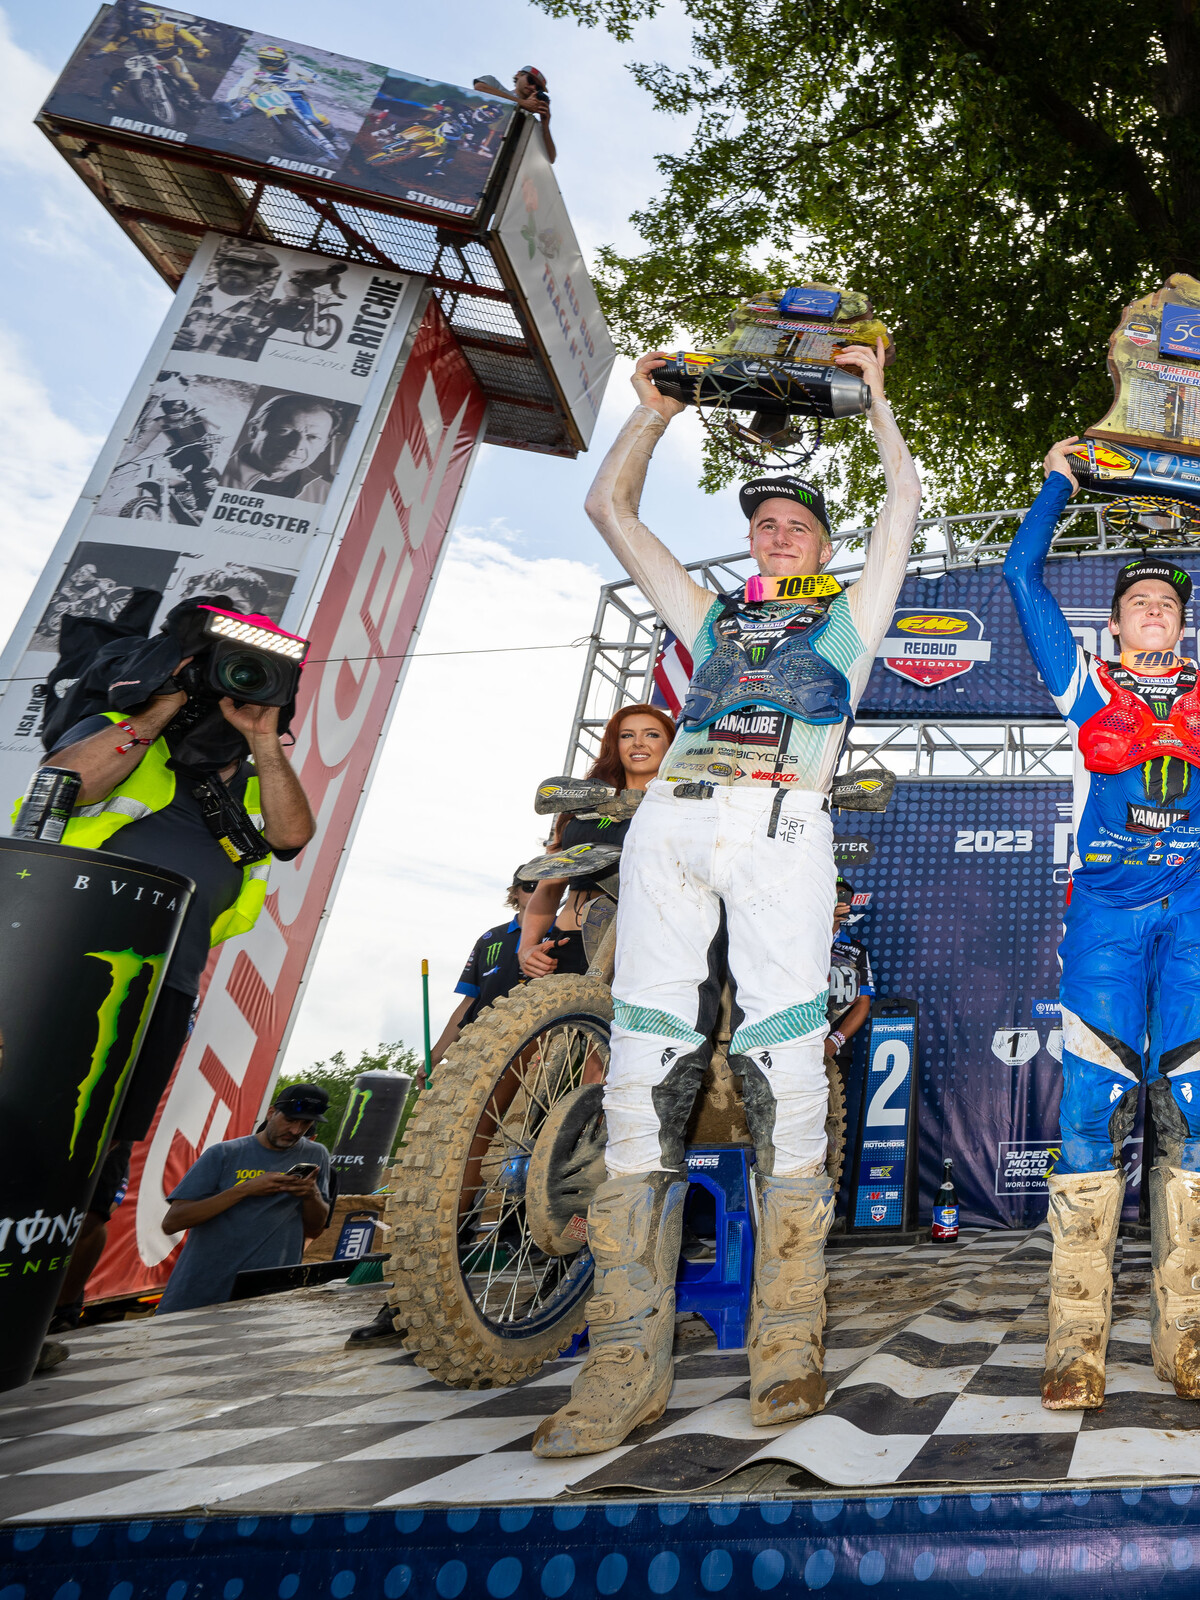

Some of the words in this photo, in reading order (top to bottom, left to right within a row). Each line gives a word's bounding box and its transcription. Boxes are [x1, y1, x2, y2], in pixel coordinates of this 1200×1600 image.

[110, 116, 188, 142] HARTWIG
[266, 156, 336, 180] BARNETT
[405, 190, 476, 215] STEWART
[791, 297, 834, 306] 50
[347, 276, 404, 350] RITCHIE
[755, 318, 778, 326] PAST
[778, 321, 832, 331] REDBUD
[776, 324, 828, 334] WINNERS
[351, 350, 376, 378] GENE
[1138, 361, 1167, 372] PAST
[754, 486, 796, 495] YAMAHA
[220, 493, 265, 508] ROGER
[212, 505, 311, 534] DECOSTER
[1136, 568, 1170, 576] YAMAHA
[776, 575, 836, 597] 100%
[720, 620, 734, 628] LK
[755, 621, 786, 629] YAMAHA
[796, 616, 813, 624] 43
[897, 617, 969, 630] FMF
[740, 630, 786, 640] THOR
[904, 642, 957, 655] REDBUD
[896, 660, 963, 668] NATIONAL
[1144, 676, 1175, 684] YAMAHA
[1180, 674, 1196, 682] 238
[1137, 685, 1178, 696] THOR
[14, 714, 35, 737] LISA
[736, 752, 799, 764] BICYCLES
[760, 772, 795, 782] BOXO
[955, 830, 1033, 853] 2023
[1105, 830, 1133, 843] YAMAHA
[829, 965, 857, 1004] 43
[866, 1039, 910, 1127] 2
[1005, 1150, 1050, 1159] SUPER
[1008, 1160, 1048, 1168] MOTO
[1004, 1168, 1048, 1177] CROSS
